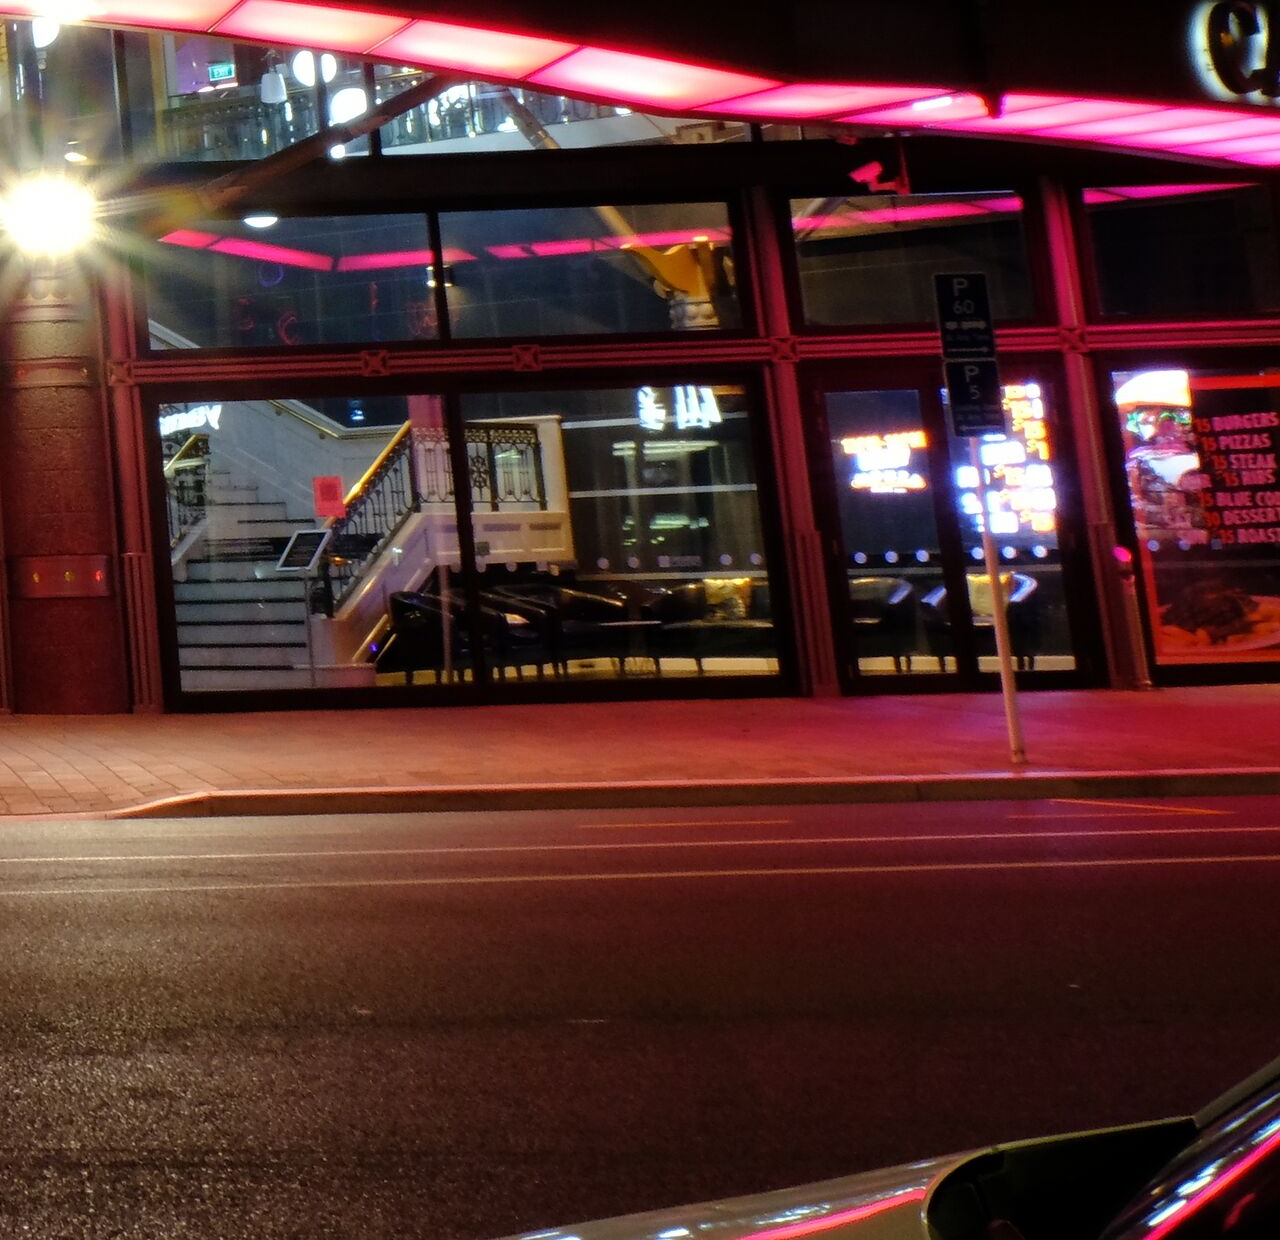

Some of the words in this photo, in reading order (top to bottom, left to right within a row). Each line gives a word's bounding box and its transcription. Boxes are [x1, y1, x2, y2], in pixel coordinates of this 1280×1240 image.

[952, 278, 968, 296] P
[953, 299, 975, 314] 60
[964, 365, 980, 383] P
[969, 384, 981, 400] 5
[1212, 412, 1279, 431] BURGERS
[1219, 433, 1272, 450] PIZZAS
[1229, 453, 1278, 470] STEAK
[1216, 491, 1253, 507] BLUE
